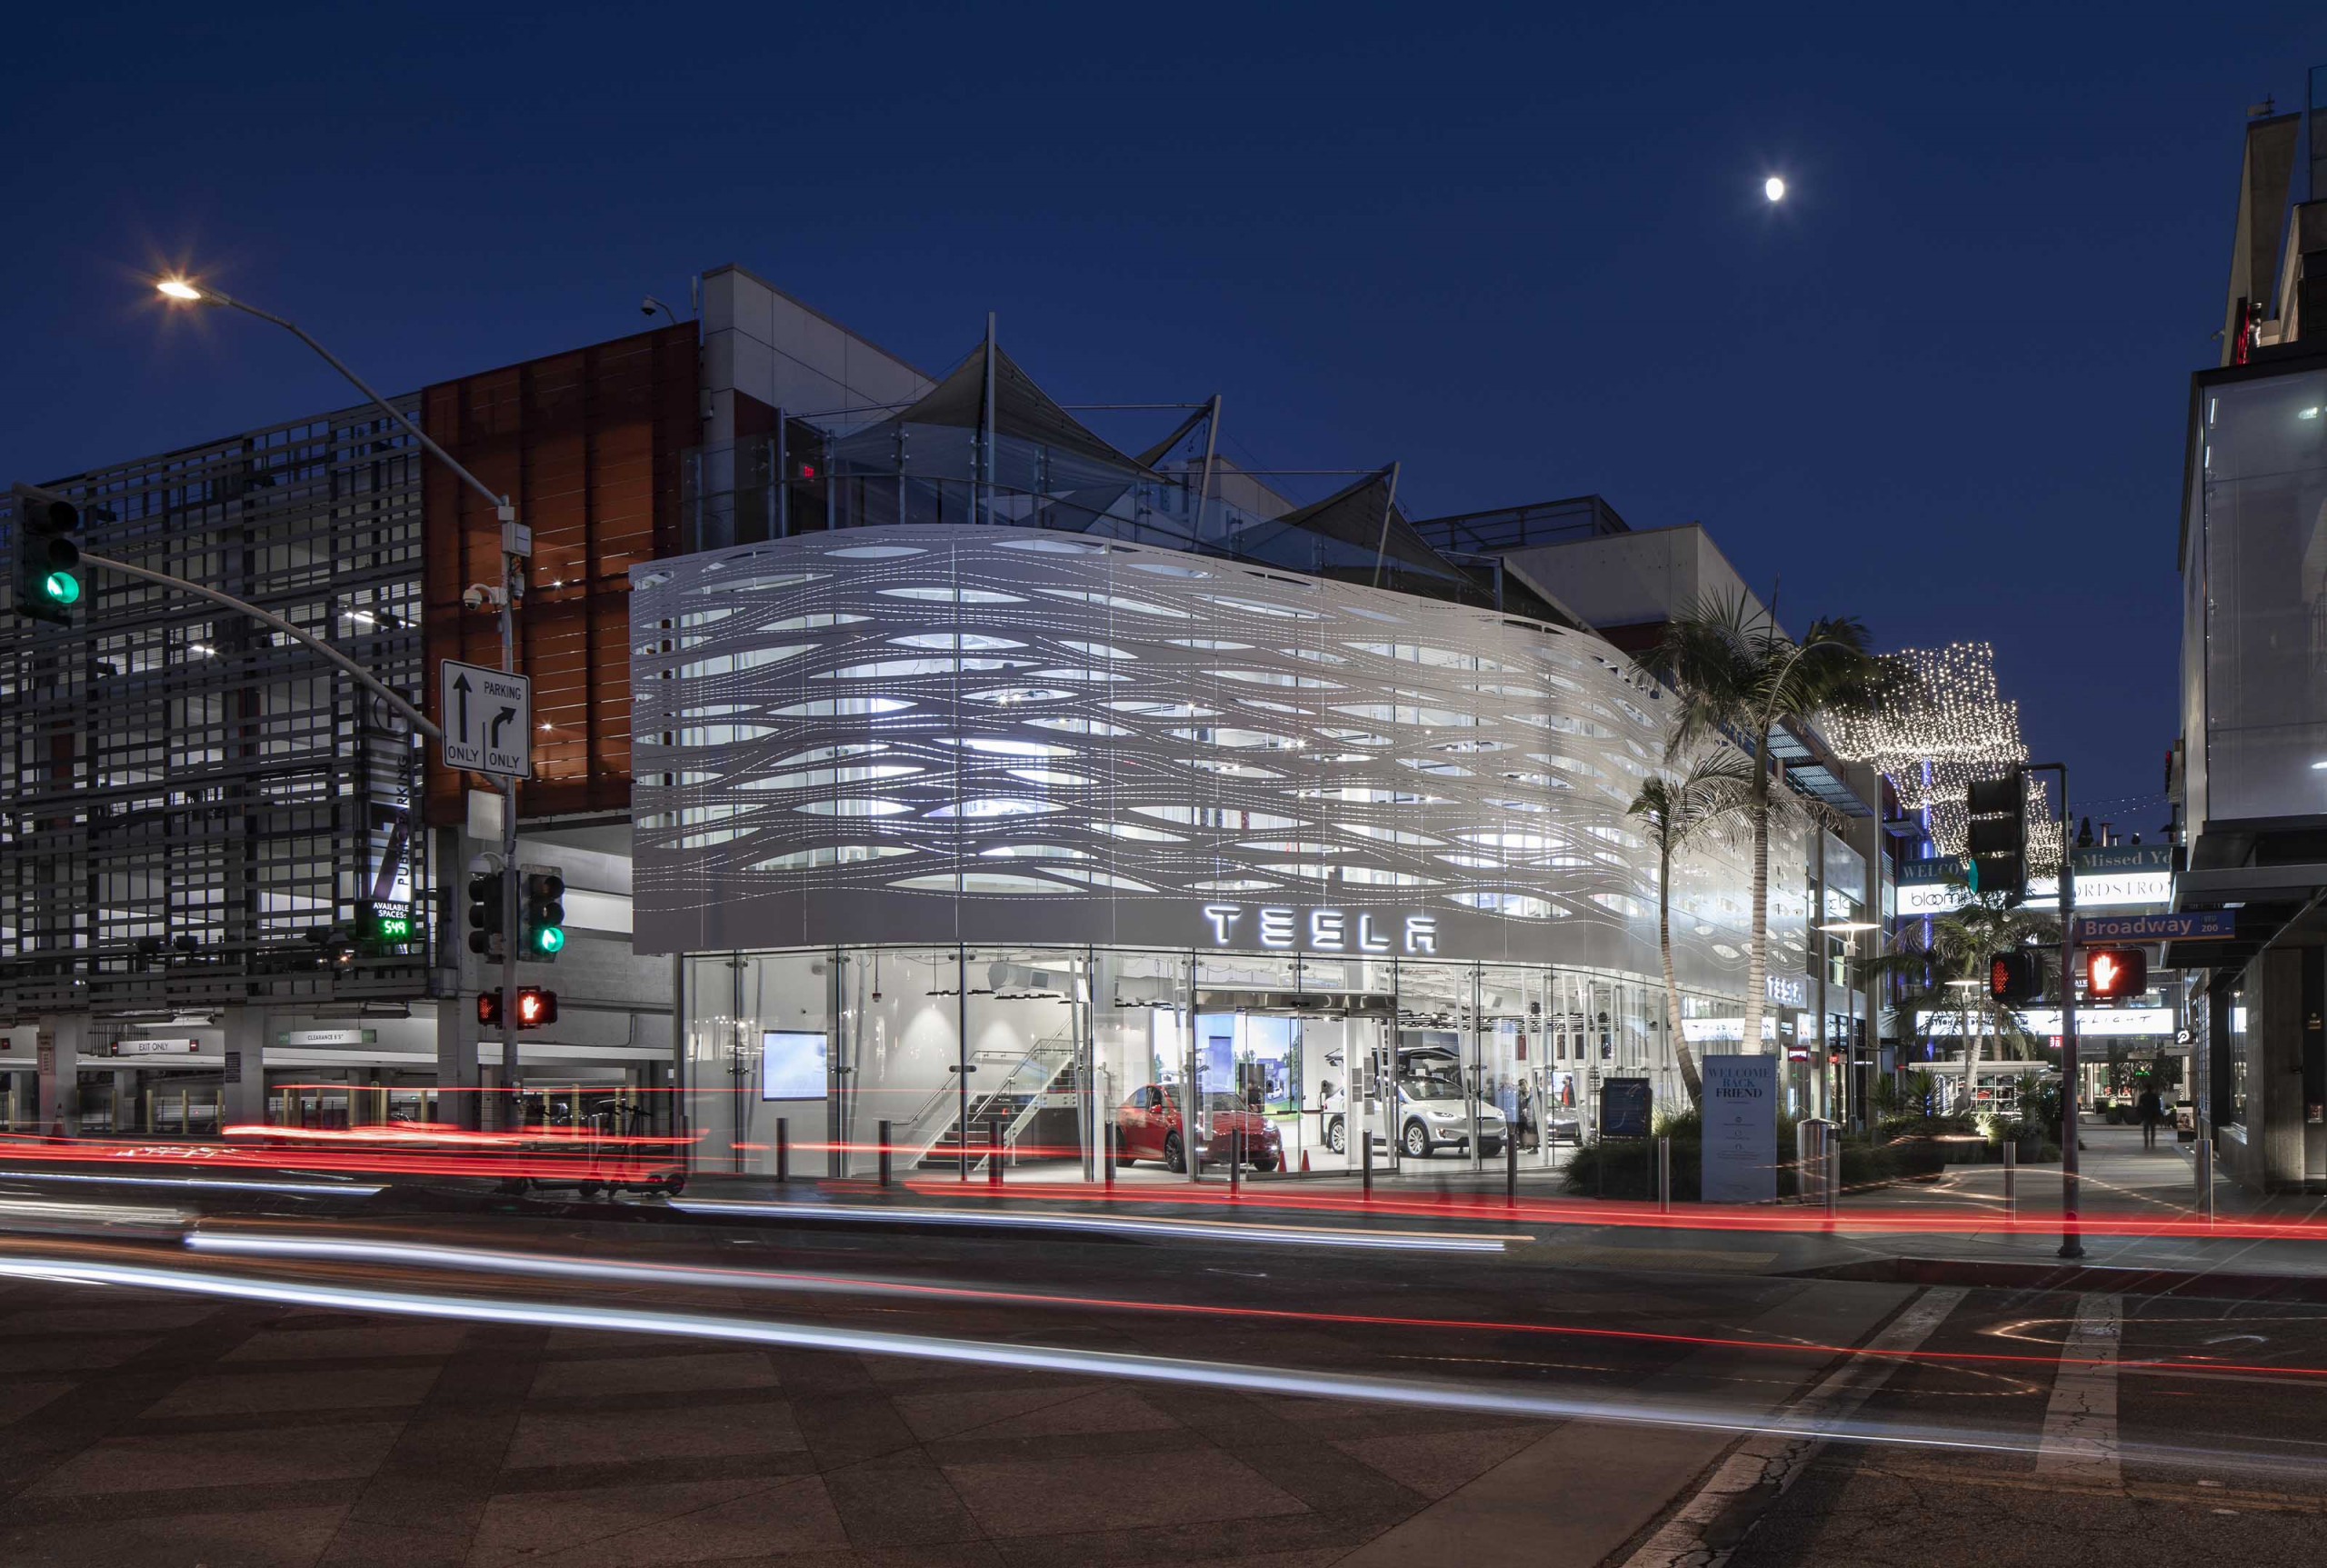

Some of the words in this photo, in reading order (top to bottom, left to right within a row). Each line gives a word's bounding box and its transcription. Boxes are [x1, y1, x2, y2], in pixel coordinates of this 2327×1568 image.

[484, 681, 521, 700] PARKING
[448, 745, 479, 763] ONLY
[489, 753, 519, 769] ONLY
[2083, 852, 2142, 867] Missed
[373, 902, 409, 912] AVAILABLE
[378, 909, 407, 919] SPACES:
[385, 920, 406, 934] 549
[1204, 905, 1438, 953] TESLA
[2085, 917, 2192, 935] Broadway
[2201, 924, 2219, 933] 200
[138, 1043, 150, 1052] EXIT
[152, 1043, 169, 1052] ONLY
[1708, 1067, 1771, 1077] WELCOME
[1723, 1077, 1755, 1088] BACK
[1716, 1087, 1763, 1098] FRIEND
